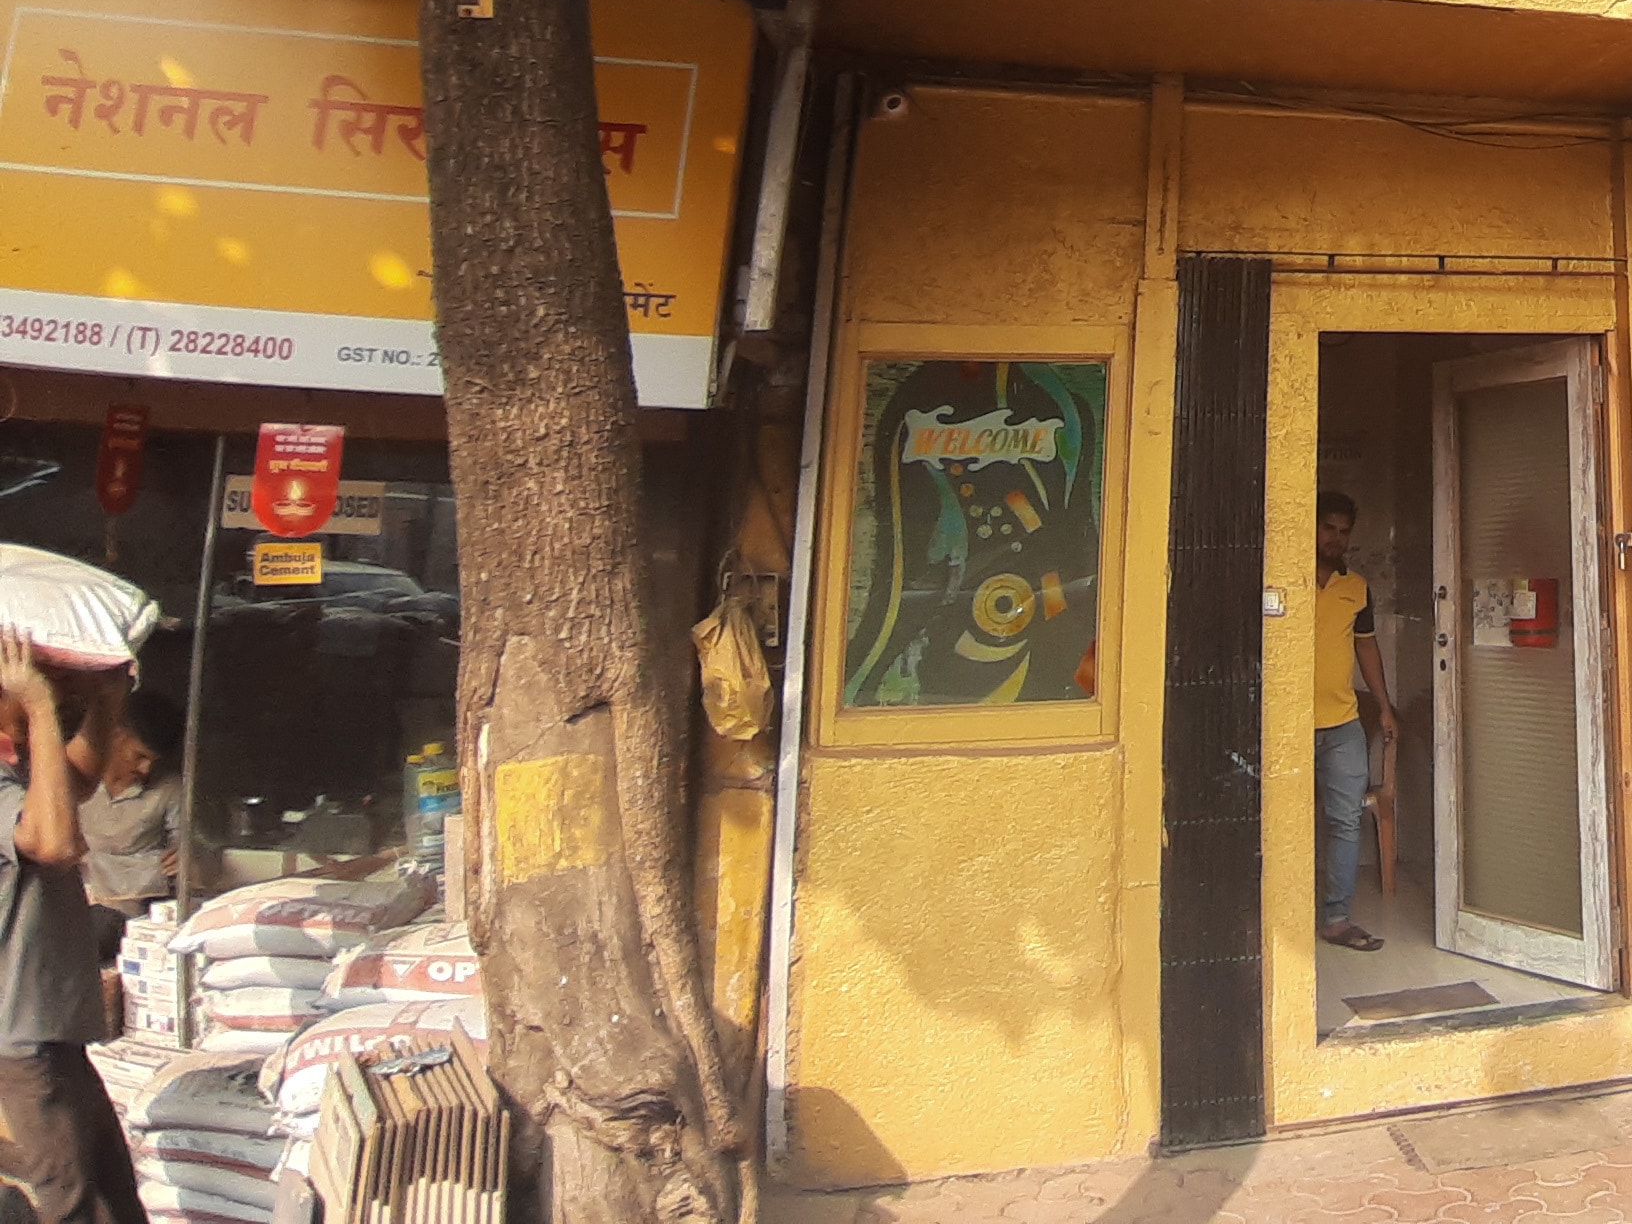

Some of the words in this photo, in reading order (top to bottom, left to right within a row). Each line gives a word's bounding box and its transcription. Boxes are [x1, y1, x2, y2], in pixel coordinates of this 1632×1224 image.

[40, 48, 269, 147] नेशनल
[0, 314, 103, 347] 3492188
[126, 327, 160, 356] (T)
[168, 329, 294, 362] 28228400
[337, 346, 378, 363] GST
[913, 427, 1050, 455] WELCOME
[259, 565, 316, 576] Cement
[427, 961, 477, 982] OP
